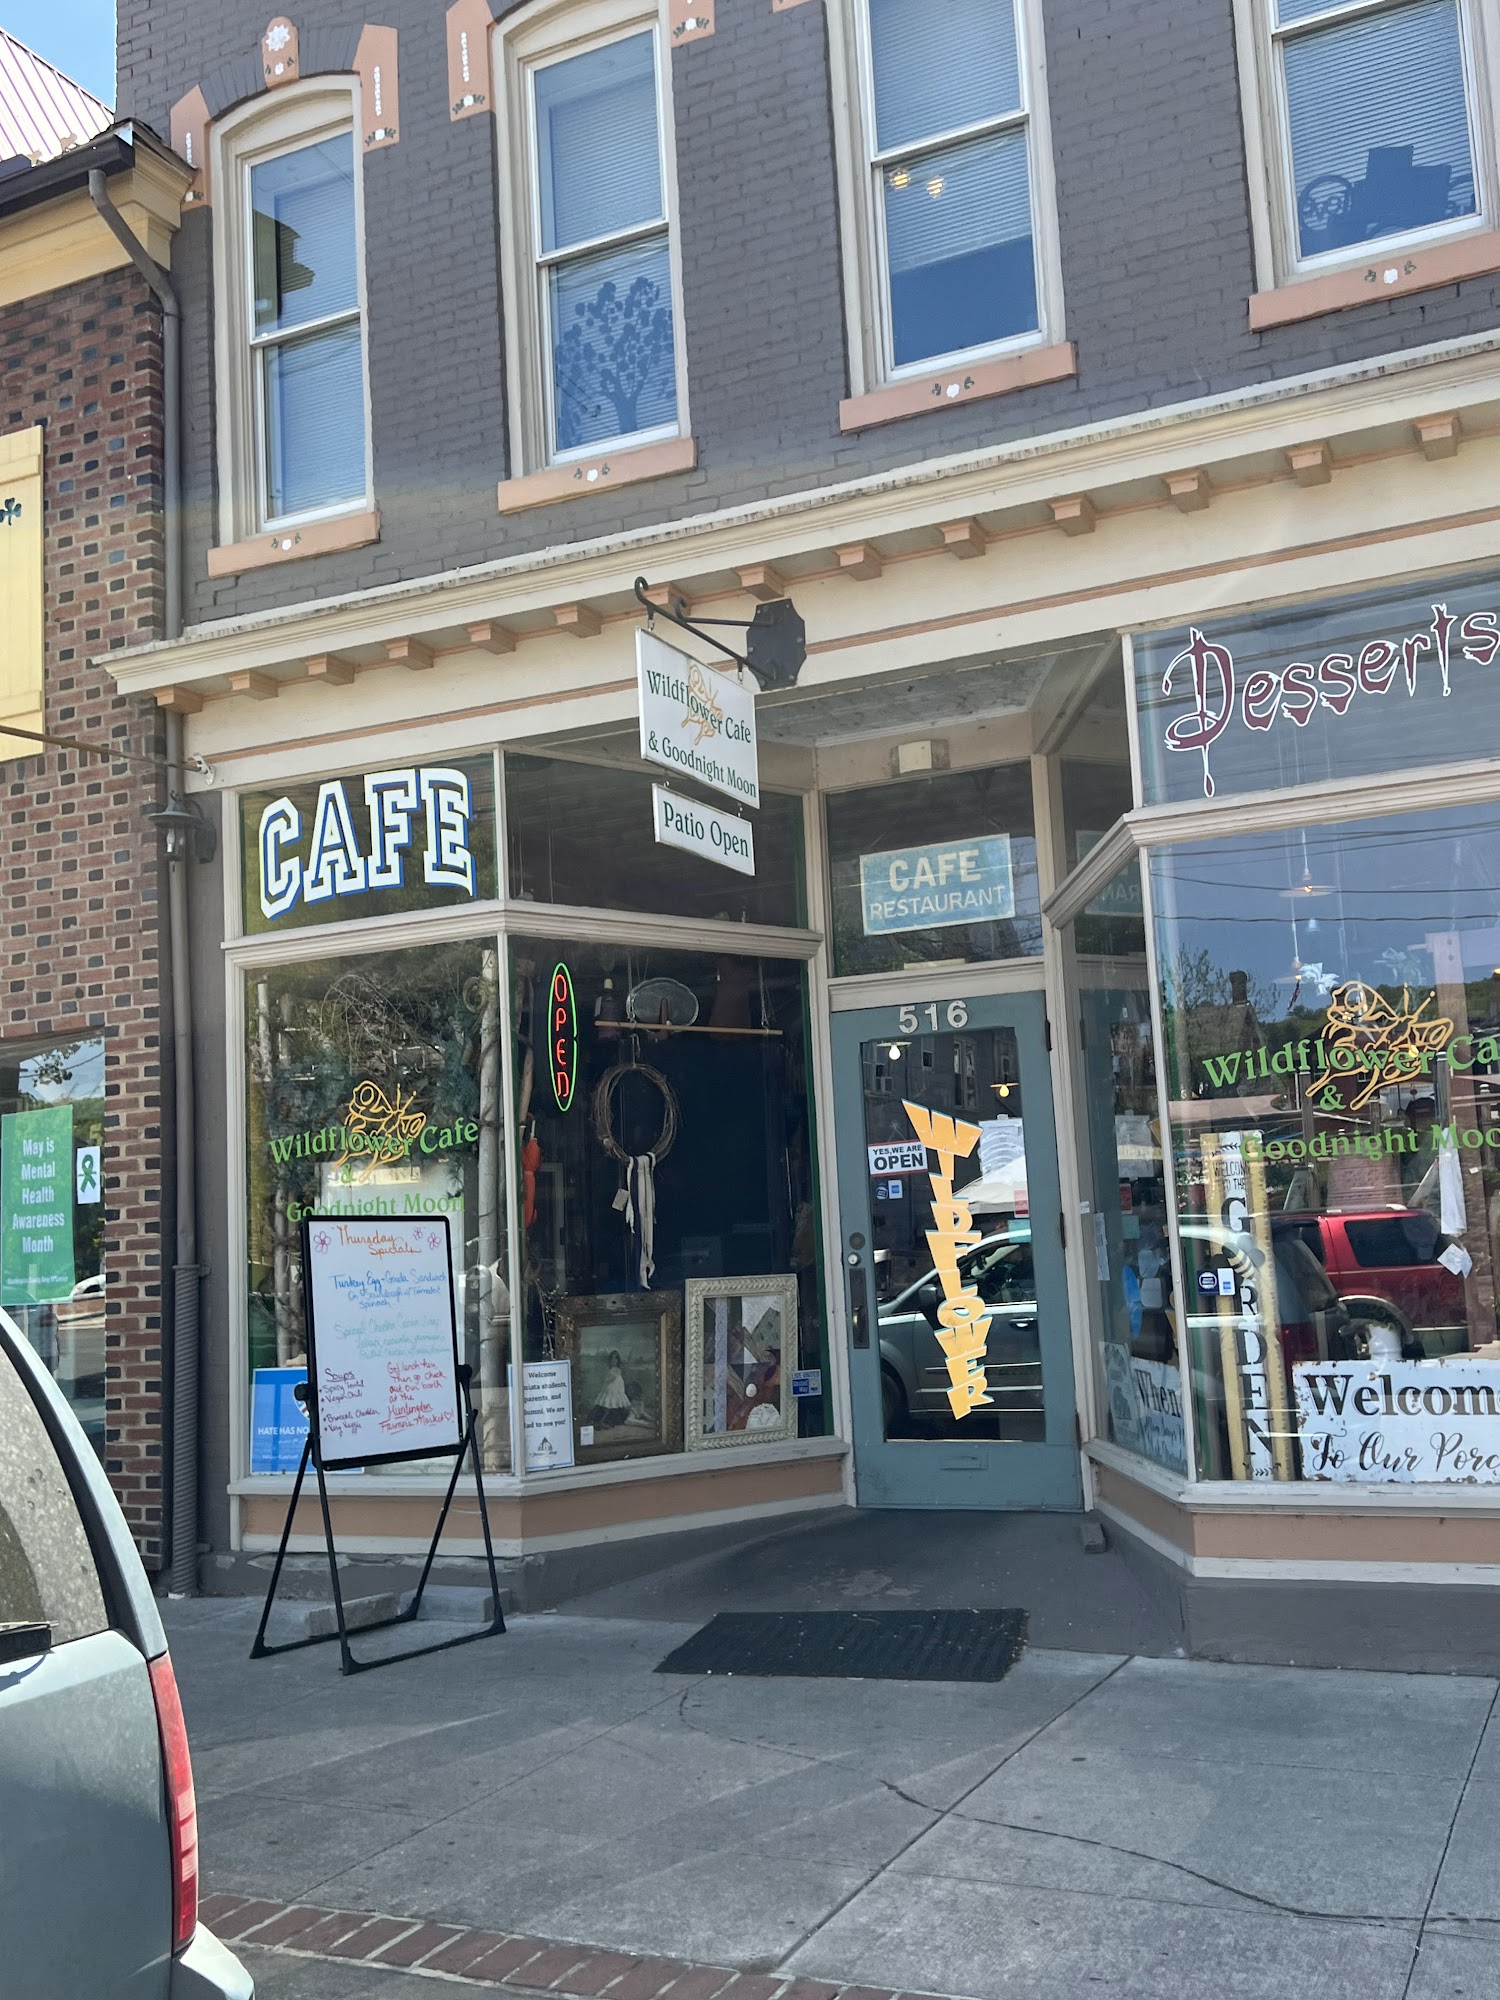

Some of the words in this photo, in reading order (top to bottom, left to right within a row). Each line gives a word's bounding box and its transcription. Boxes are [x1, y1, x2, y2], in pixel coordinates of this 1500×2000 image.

[647, 670, 722, 734] Wildflower
[725, 717, 751, 744] Cafe
[1161, 603, 1500, 797] Desserts
[649, 730, 658, 753] &
[662, 737, 724, 782] Goodnight
[727, 767, 756, 798] Moon
[257, 767, 477, 921] CAFE
[663, 801, 704, 840] Patio
[710, 820, 749, 858] Open
[888, 848, 983, 893] CAFE
[870, 884, 1006, 920] RESTAURANT
[554, 973, 570, 1098] OPEN
[898, 999, 969, 1034] 516
[1202, 1037, 1436, 1089] Wildflower
[1445, 1033, 1500, 1071] Ca
[1319, 1085, 1347, 1112] &
[22, 1139, 43, 1158] May
[46, 1136, 54, 1153] is
[269, 1125, 415, 1165] Wildflower
[419, 1116, 479, 1154] Cafe
[906, 1144, 922, 1152] ARE
[1239, 1127, 1420, 1163] Goodnight
[1430, 1123, 1500, 1153] Moo
[22, 1161, 56, 1180] Mental
[340, 1163, 357, 1184] &
[874, 1153, 924, 1170] OPEN
[22, 1186, 54, 1204] Health
[286, 1195, 396, 1223] Goodnight
[403, 1192, 465, 1214] Moon
[12, 1212, 64, 1230] Awareness
[22, 1236, 54, 1254] Month
[1221, 1197, 1275, 1455] GRDEN
[1135, 1368, 1182, 1418] When
[1302, 1374, 1500, 1417] Welcom
[257, 1426, 278, 1436] HATE
[279, 1426, 296, 1435] HAS
[296, 1426, 310, 1434] NO
[1358, 1430, 1424, 1473] Our
[1429, 1431, 1500, 1473] Porc
